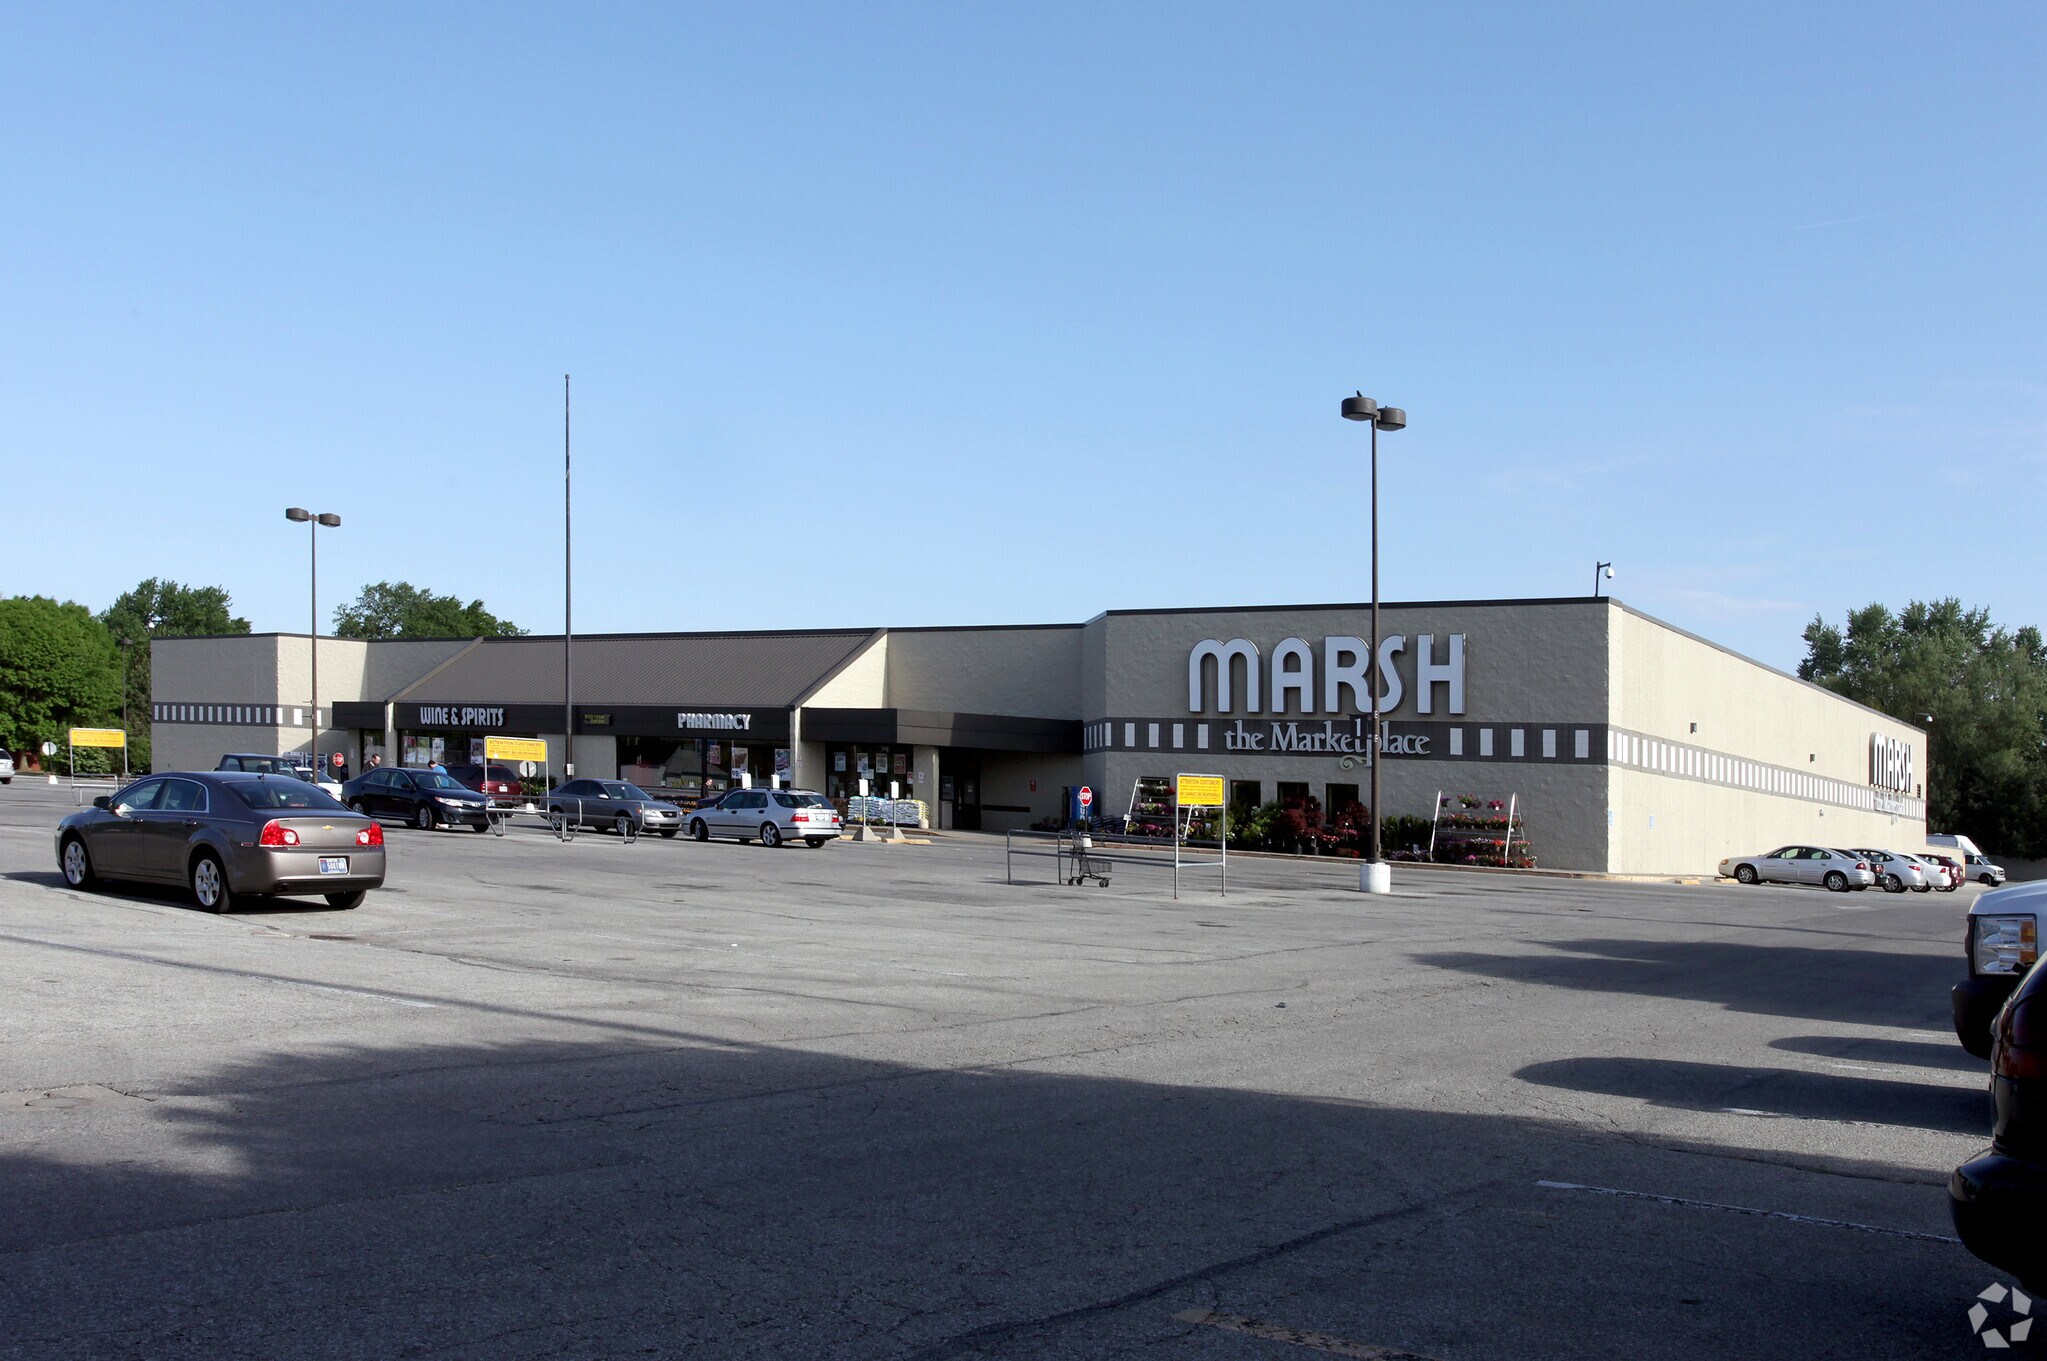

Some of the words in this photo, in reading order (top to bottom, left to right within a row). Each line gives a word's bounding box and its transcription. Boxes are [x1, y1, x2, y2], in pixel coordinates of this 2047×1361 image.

[1189, 633, 1466, 714] MARSH
[420, 707, 449, 725] WINE
[451, 707, 459, 725] &
[461, 707, 504, 727] SPIRITS
[677, 713, 751, 730] PHARMACY
[1225, 720, 1264, 751] the
[1873, 732, 1912, 793] MARSH
[1081, 792, 1092, 800] STOP
